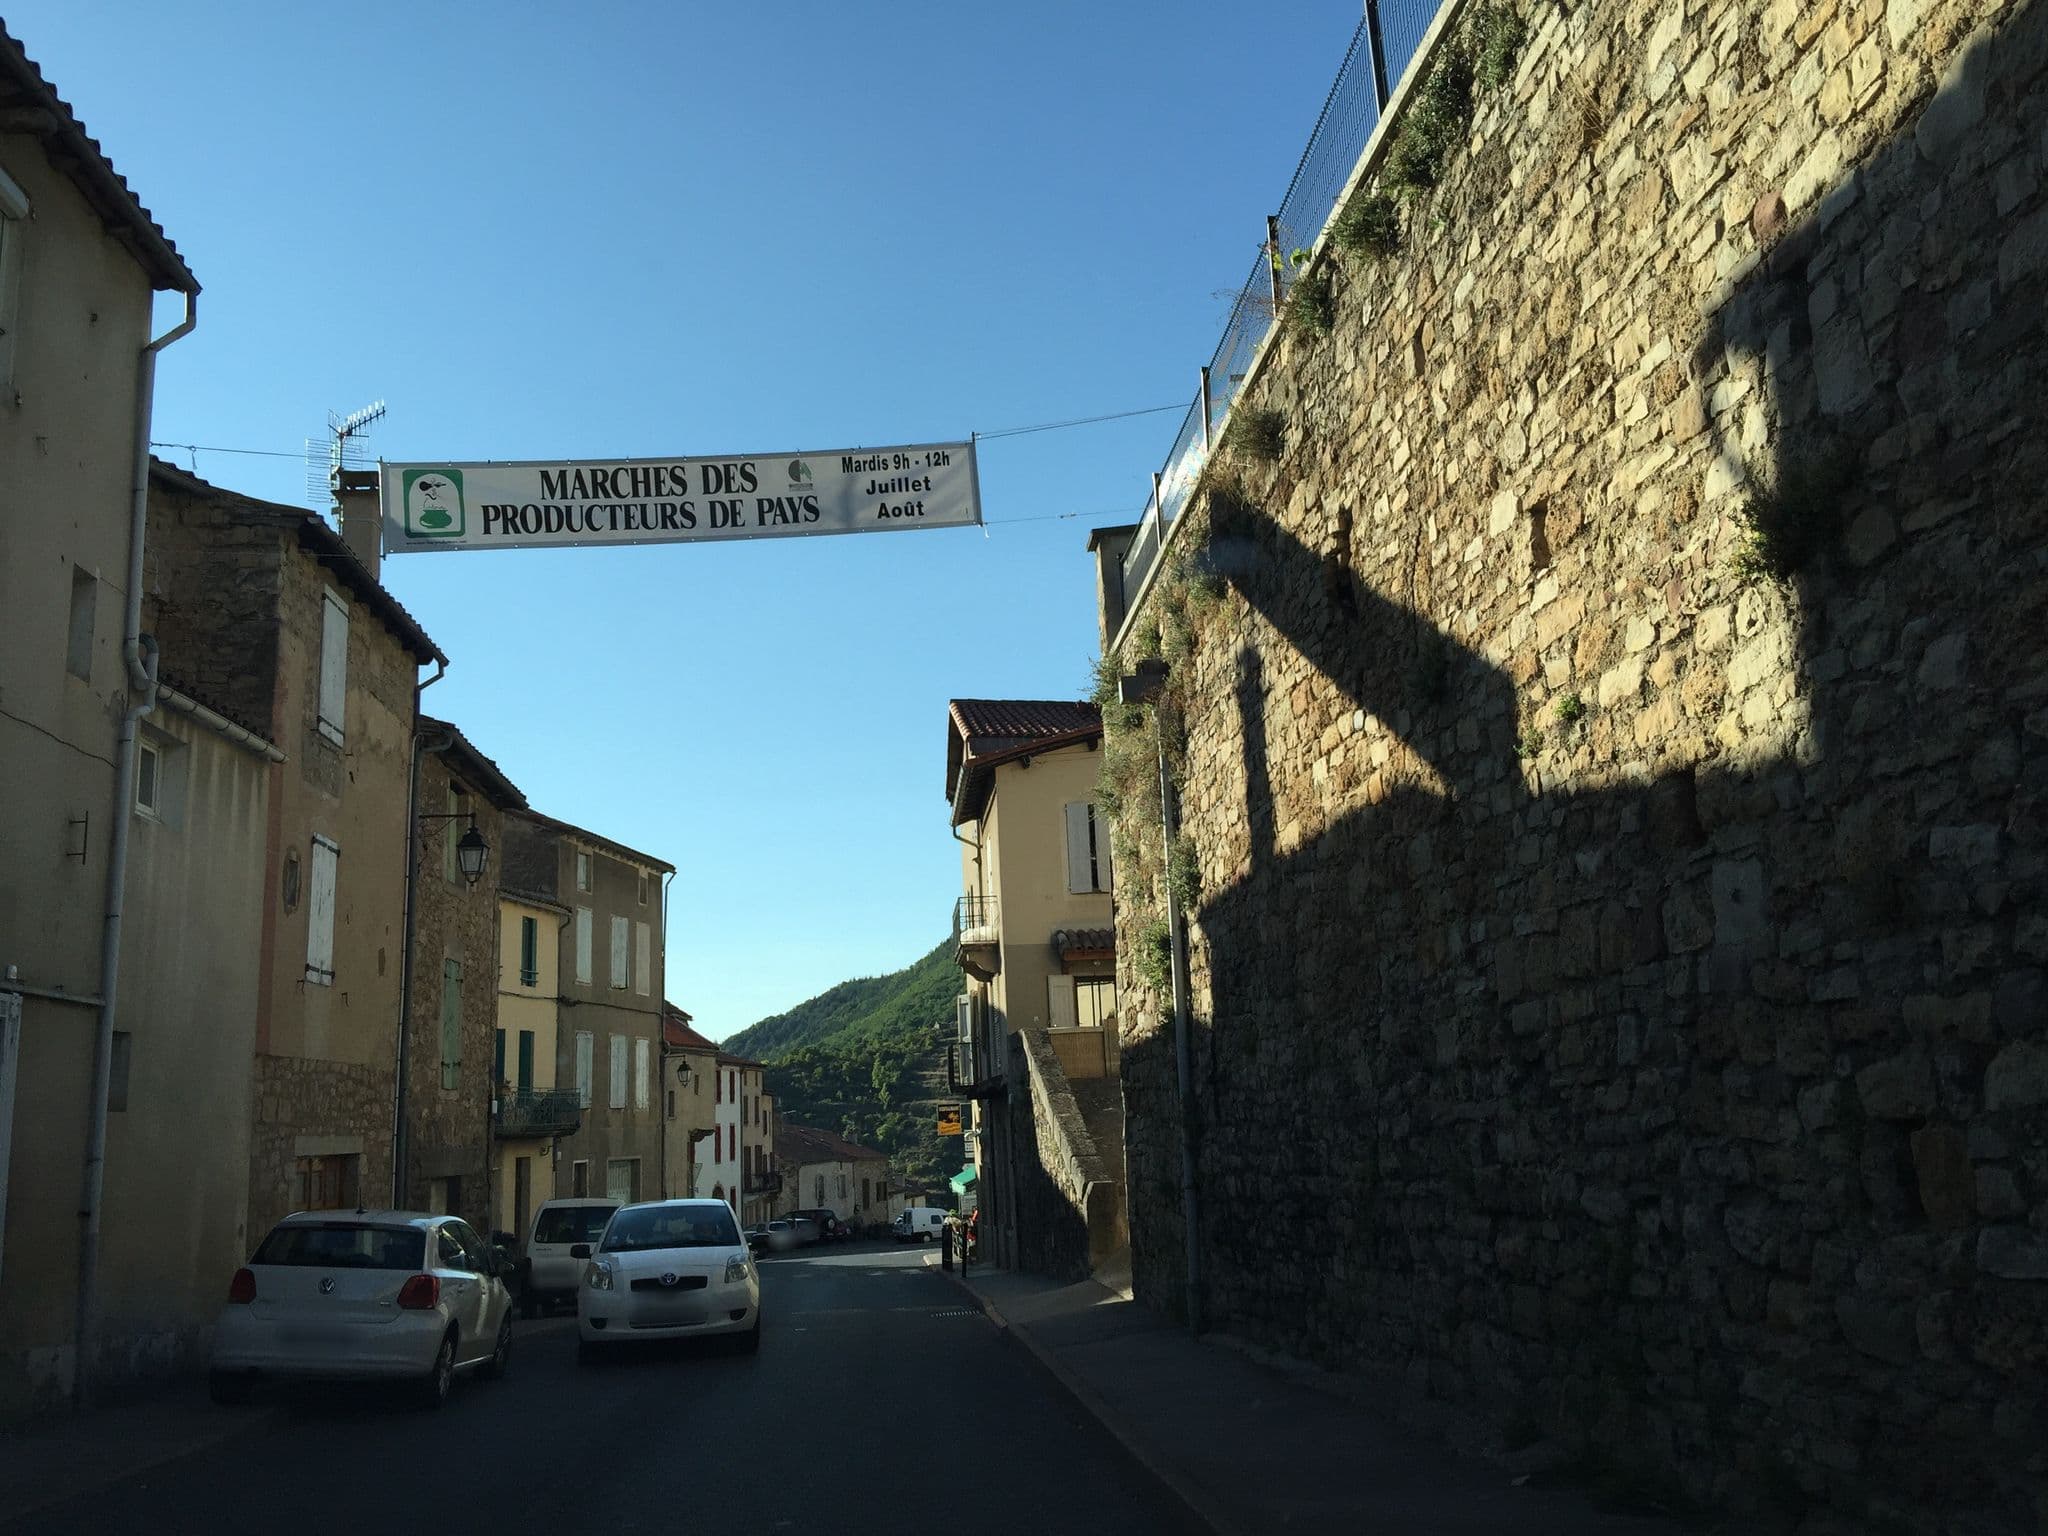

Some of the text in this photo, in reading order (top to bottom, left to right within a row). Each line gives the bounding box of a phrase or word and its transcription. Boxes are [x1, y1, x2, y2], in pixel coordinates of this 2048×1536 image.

[841, 455, 889, 473] Mardis
[893, 453, 910, 470] 9h
[925, 451, 950, 467] 12h
[539, 464, 758, 500] MARCHES DES
[866, 476, 931, 495] Juillet
[481, 495, 820, 535] PRODUCTEURS DE PAYS
[877, 501, 924, 519] Août
